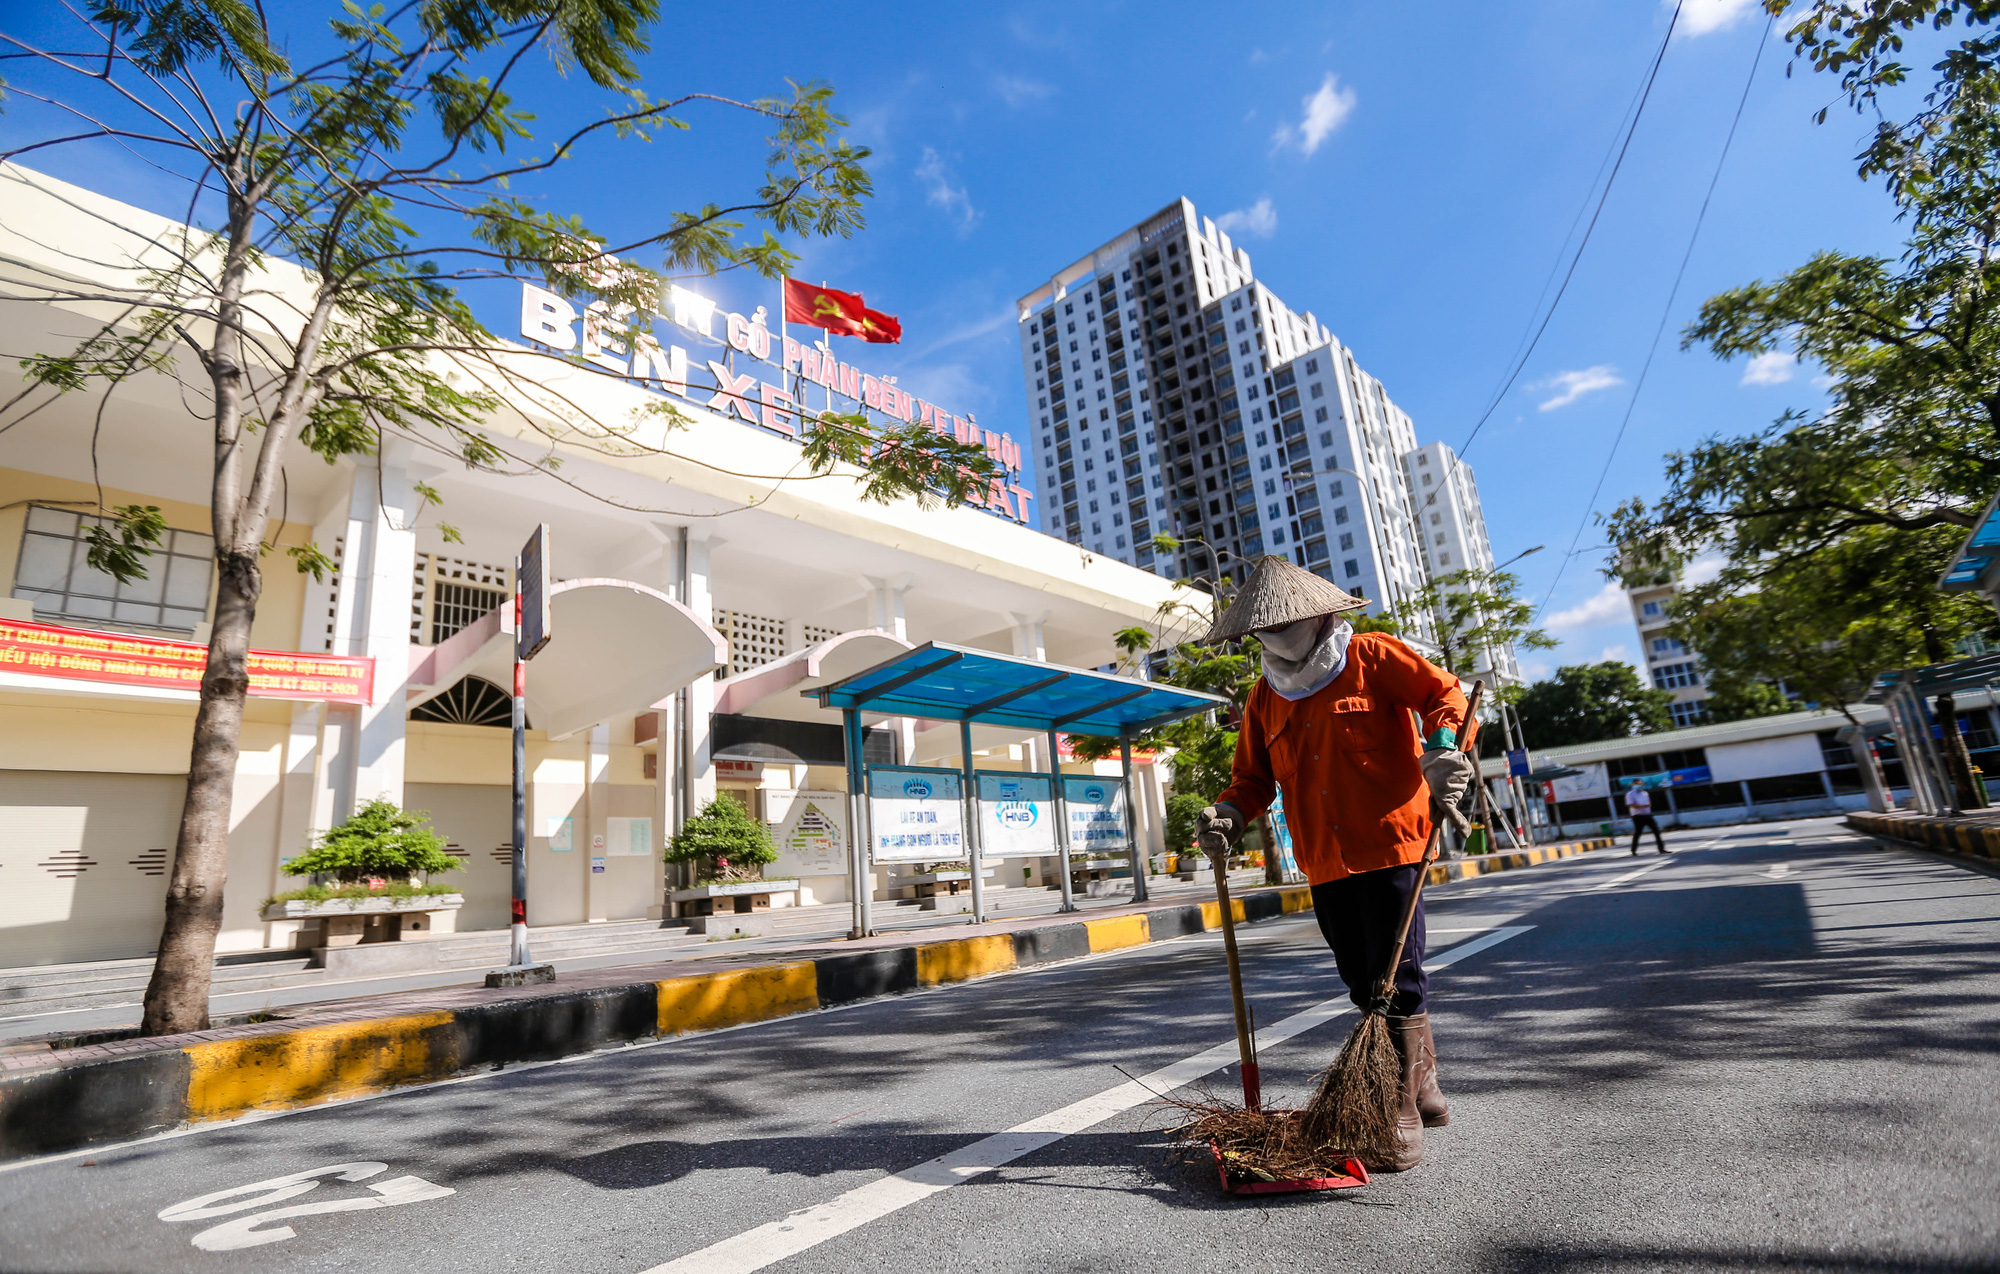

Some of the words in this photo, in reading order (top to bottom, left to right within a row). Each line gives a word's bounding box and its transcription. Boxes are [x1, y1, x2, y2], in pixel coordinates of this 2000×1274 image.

[706, 360, 797, 438] XE
[727, 305, 771, 361] CỔ
[783, 336, 860, 400] PHẦN
[863, 373, 913, 424] BẾN
[916, 398, 948, 438] XE
[952, 413, 982, 448] HÀ
[985, 431, 1022, 473] NỘI
[0, 645, 26, 664] IỂU
[28, 651, 57, 669] HỘI
[59, 653, 104, 671] ĐỒNG
[104, 660, 147, 676] NHÂN
[148, 663, 179, 679] DÂN
[300, 680, 359, 696] 2021-2026
[16, 629, 60, 647] CHÀO
[63, 634, 110, 652] MỪNG
[111, 641, 151, 656] NGÀY
[153, 644, 183, 660] BẦU
[262, 656, 295, 672] QUỐC
[296, 659, 316, 676] HỘI
[350, 667, 365, 679] XV
[1005, 812, 1030, 822] HNB
